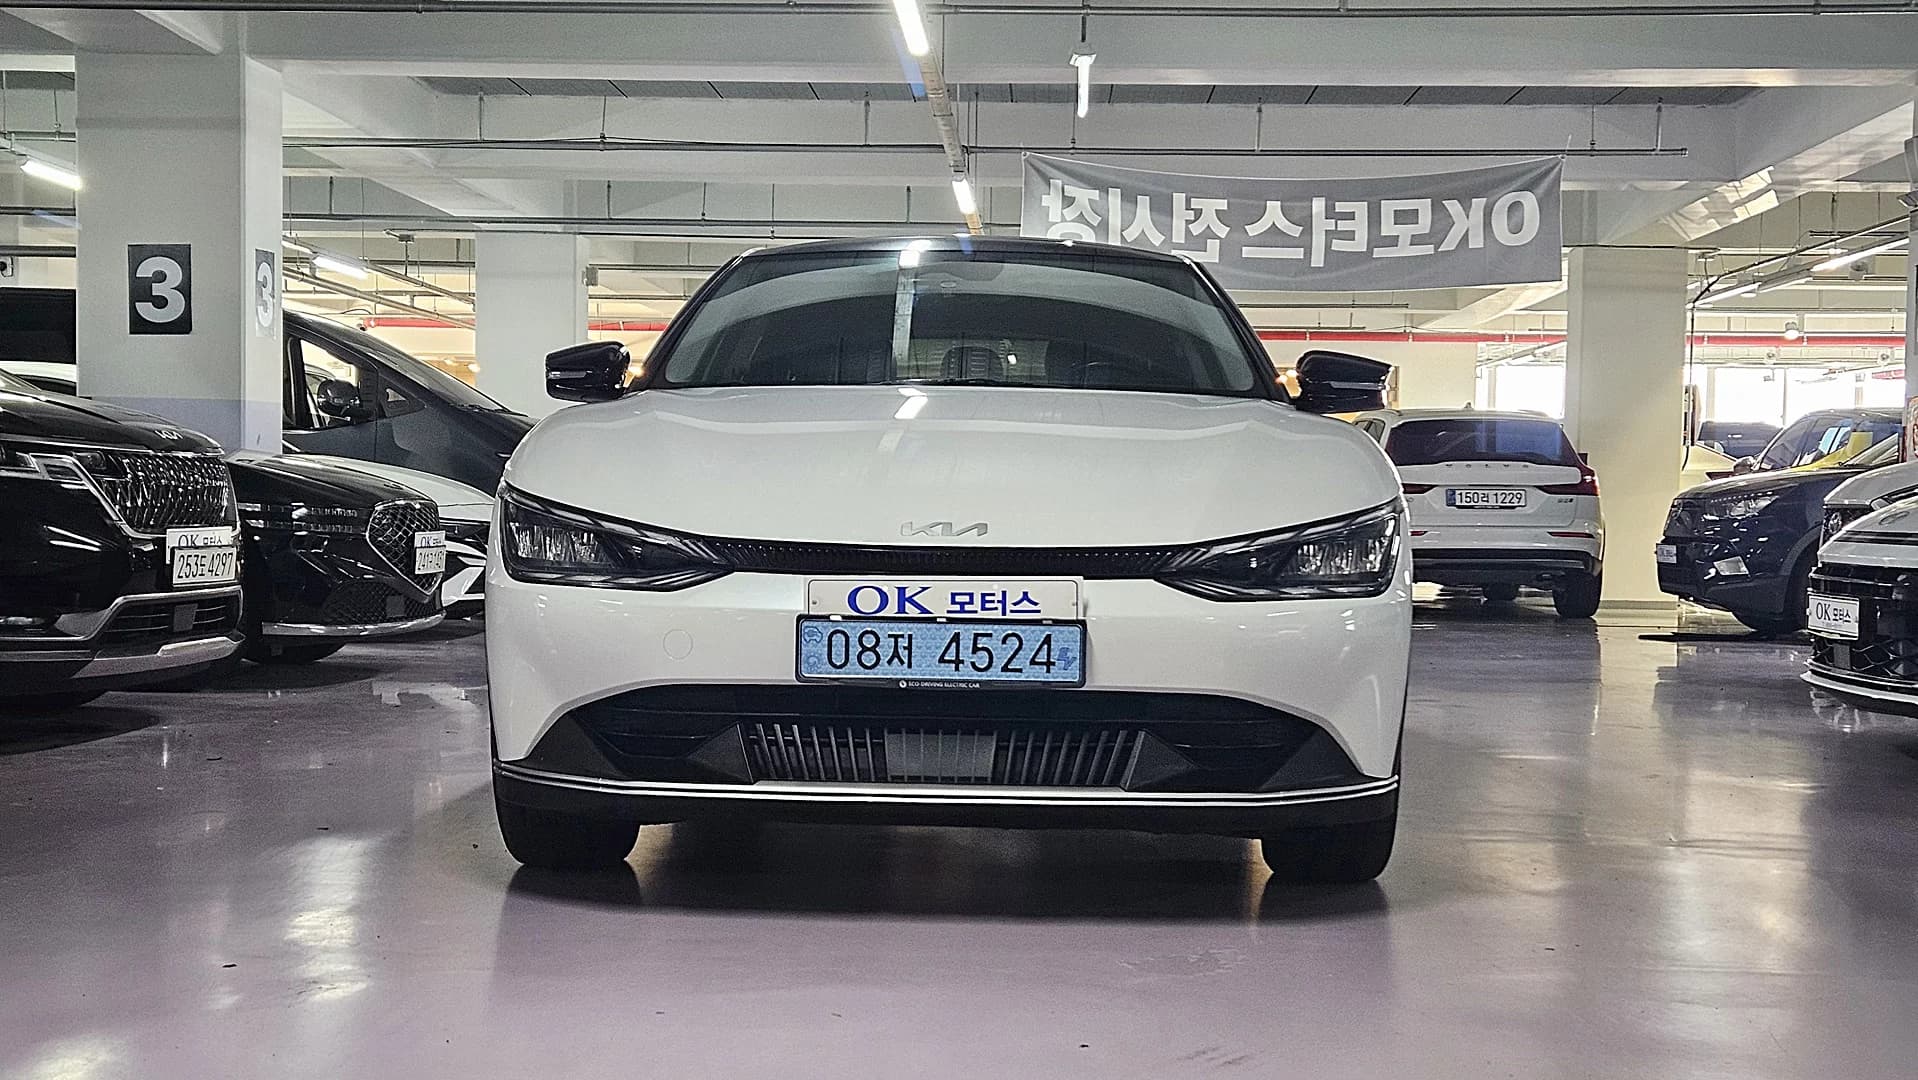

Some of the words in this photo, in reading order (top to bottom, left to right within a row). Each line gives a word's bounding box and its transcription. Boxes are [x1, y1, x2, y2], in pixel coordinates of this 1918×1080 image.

[135, 256, 186, 323] 3
[257, 262, 273, 328] 3
[1493, 492, 1523, 504] 1229
[178, 534, 199, 546] OK
[207, 552, 234, 576] 4297
[847, 585, 934, 615] OK
[946, 590, 1042, 617] 모터스
[1816, 602, 1831, 621] OK
[826, 628, 913, 670] 08저
[938, 631, 1057, 674] 4524
